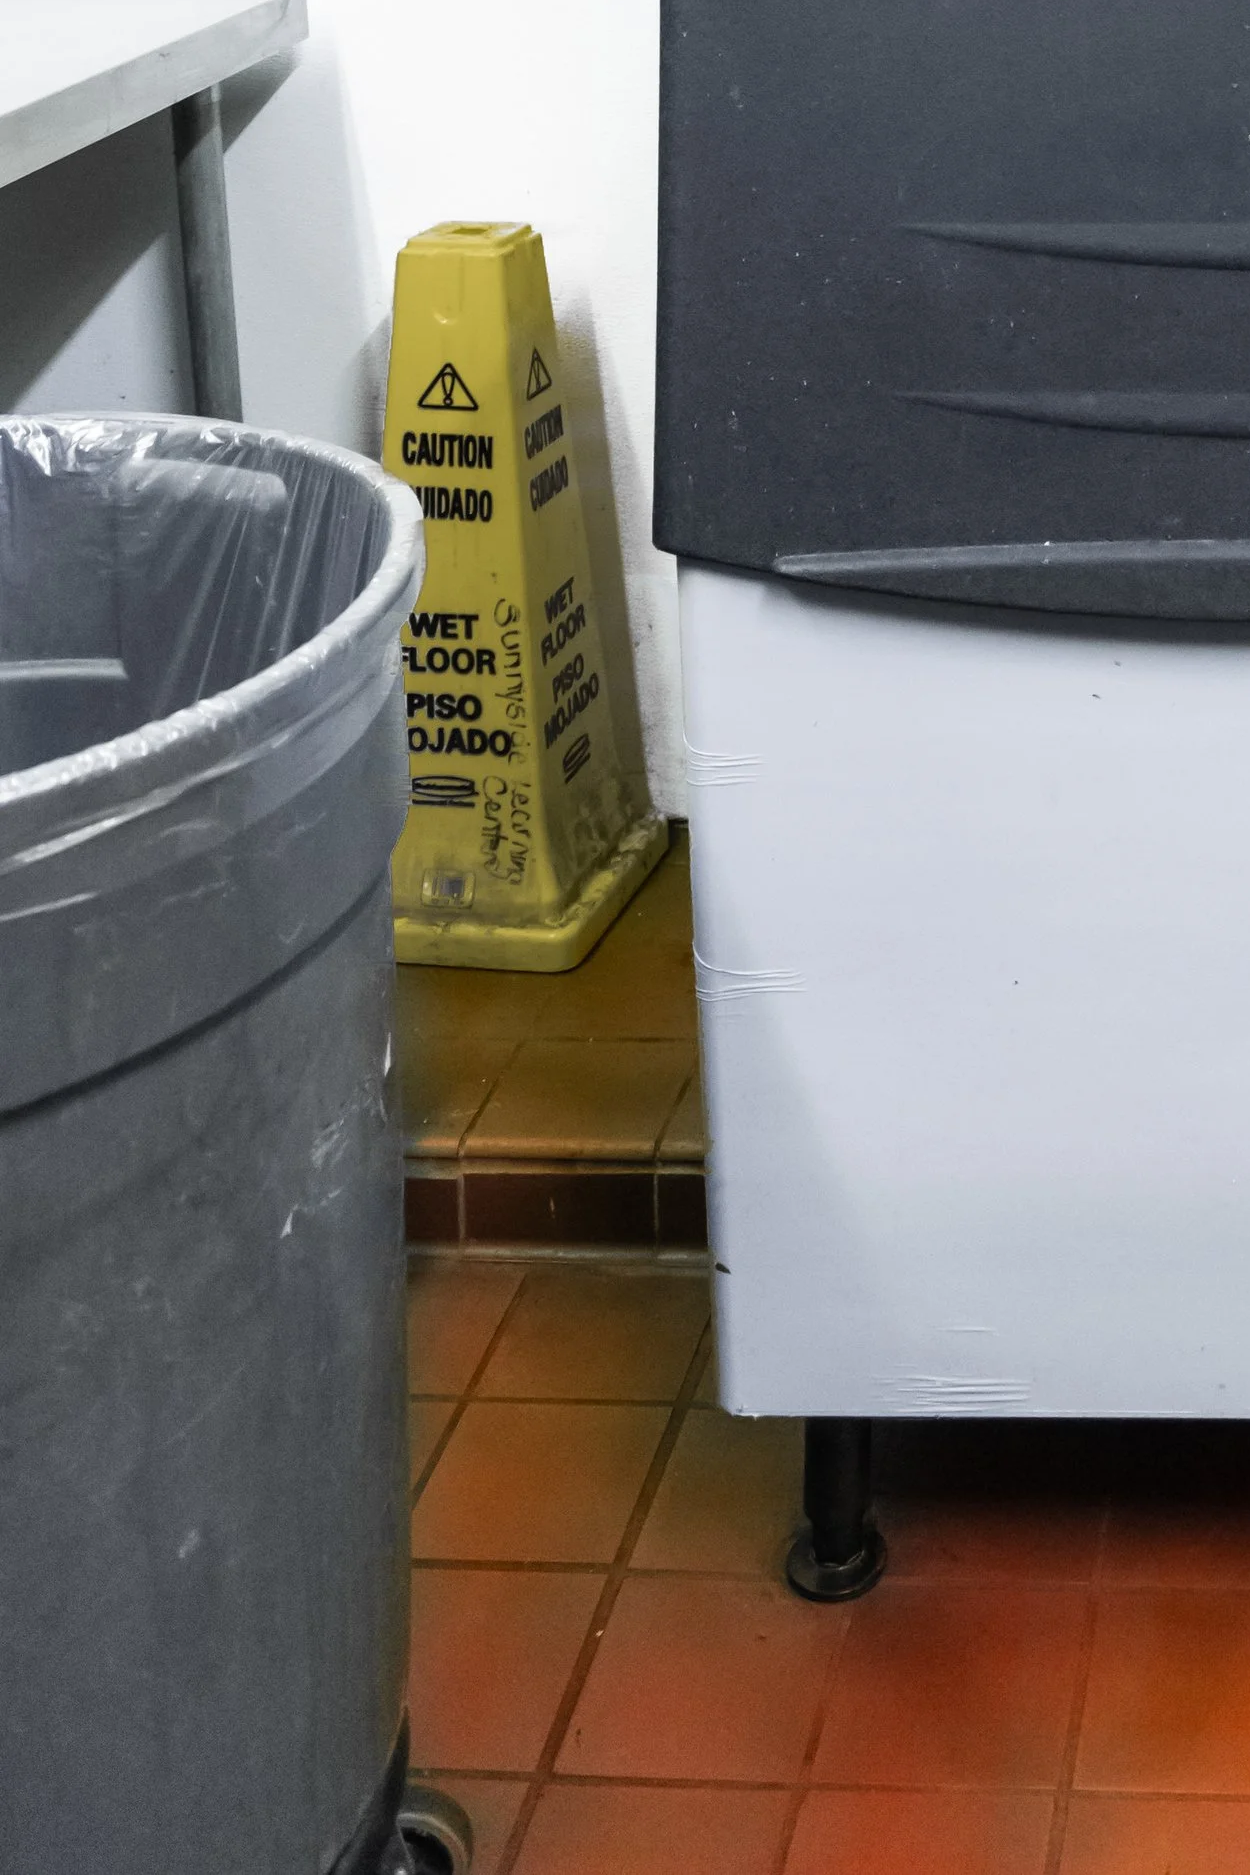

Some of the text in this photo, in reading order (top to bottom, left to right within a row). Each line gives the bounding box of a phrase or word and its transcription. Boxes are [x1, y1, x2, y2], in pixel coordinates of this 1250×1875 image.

[402, 431, 493, 469] CAUTION
[523, 404, 564, 460] CAUTION
[411, 486, 493, 523] UIDADO
[529, 455, 569, 512] CUIDADO
[544, 576, 575, 624] WET
[409, 612, 479, 640] WET
[541, 603, 586, 667] FLOOR
[494, 597, 531, 766] Sunnyside
[552, 653, 584, 705] PISO
[406, 693, 482, 721] PISO
[544, 673, 599, 750] MOJADO
[408, 727, 512, 757] OJADO
